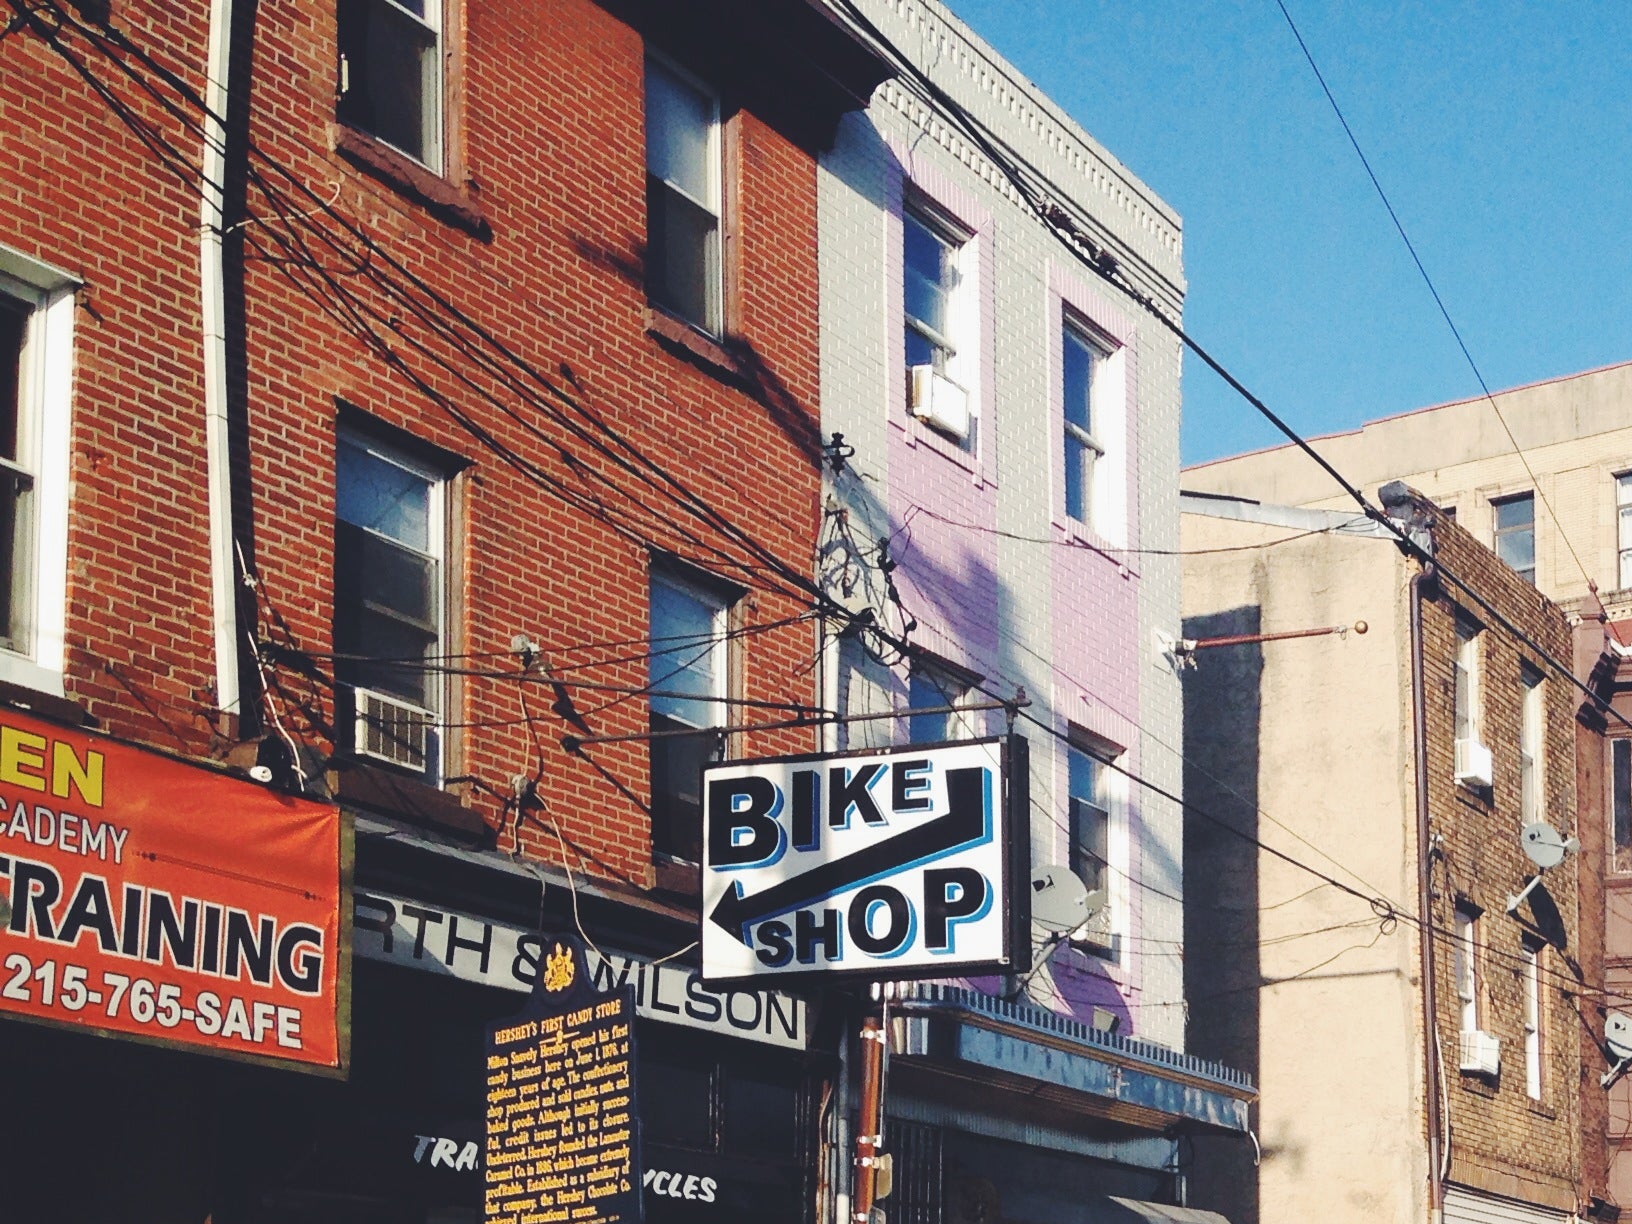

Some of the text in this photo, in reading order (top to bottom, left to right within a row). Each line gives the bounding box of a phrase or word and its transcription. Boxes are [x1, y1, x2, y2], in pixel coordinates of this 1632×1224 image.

[0, 726, 104, 807] EN
[709, 759, 933, 871] BIKE
[755, 867, 993, 968] SHOP
[3, 954, 302, 1049] 215-765-SAFE
[592, 953, 798, 1040] WILSON
[495, 999, 621, 1045] HERSHEY'S FIRST CANDY STORE
[540, 1042, 568, 1058] Hershey
[572, 1032, 596, 1052] opened
[599, 1028, 609, 1042] his
[612, 1024, 628, 1039] first
[487, 1070, 508, 1086] candy
[512, 1065, 541, 1080] business
[545, 1060, 561, 1073] here
[565, 1058, 574, 1068] on
[576, 1052, 593, 1065] June
[520, 1083, 538, 1100] years
[541, 1076, 550, 1090] of
[567, 1070, 580, 1084] The
[583, 1061, 628, 1080] confectionery
[506, 1095, 539, 1117] produced
[542, 1092, 555, 1107] and
[558, 1089, 571, 1103] sold
[616, 1074, 629, 1089] and
[487, 1118, 508, 1134] baked
[538, 1106, 570, 1124] Although
[505, 1131, 529, 1147] credit
[534, 1129, 556, 1142] issues
[561, 1122, 573, 1136] led
[578, 1121, 585, 1132] to
[589, 1118, 598, 1130] its
[413, 1135, 479, 1172] TRA
[528, 1144, 556, 1159] Hershey
[559, 1136, 585, 1153] founded
[587, 1134, 598, 1148] the
[554, 1156, 574, 1171] which
[576, 1154, 598, 1167] became
[527, 1174, 567, 1192] Established
[540, 1194, 553, 1206] the
[557, 1189, 585, 1204] Hershey
[588, 1182, 617, 1199] Chocolate
[521, 1206, 568, 1224] international
